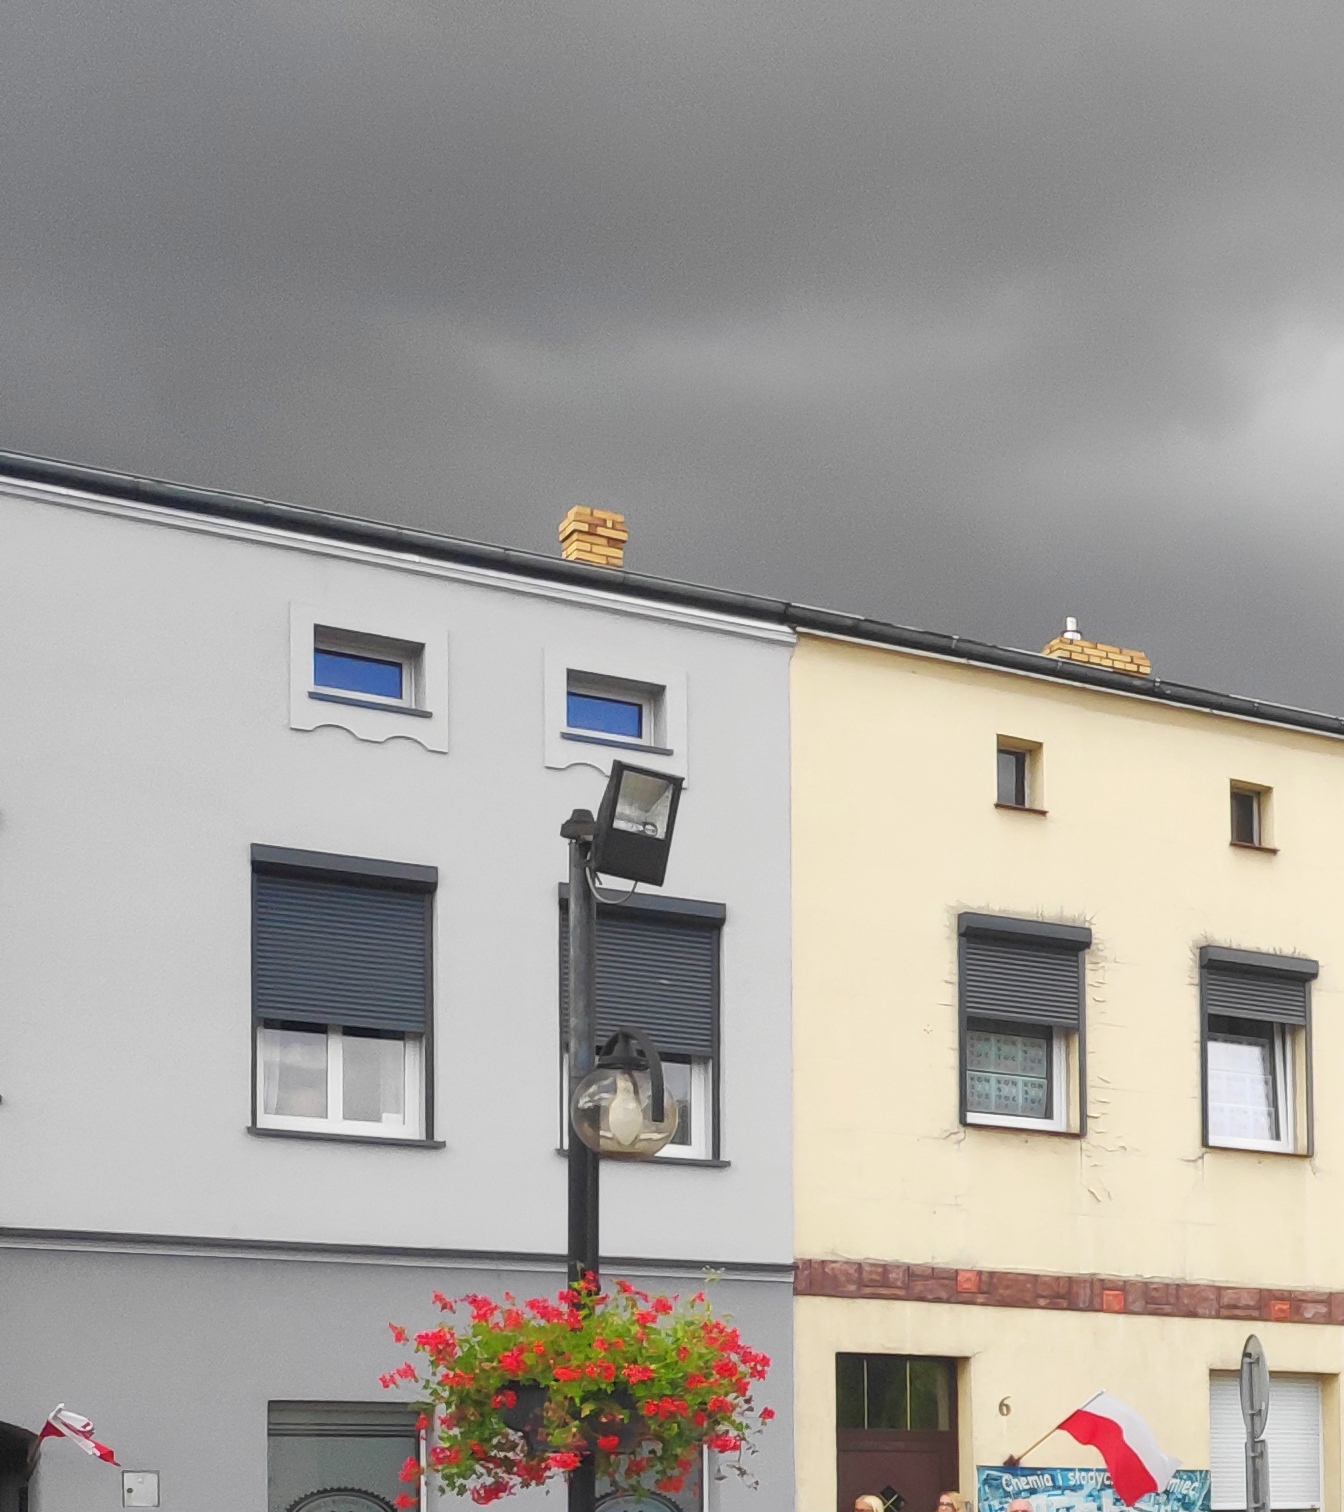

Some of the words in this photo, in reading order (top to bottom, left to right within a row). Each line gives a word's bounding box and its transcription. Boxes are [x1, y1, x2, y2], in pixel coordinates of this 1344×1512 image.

[998, 1396, 1011, 1417] 6
[1002, 1471, 1053, 1492] Chemia
[1056, 1469, 1063, 1486] i
[1067, 1468, 1115, 1490] słodyc
